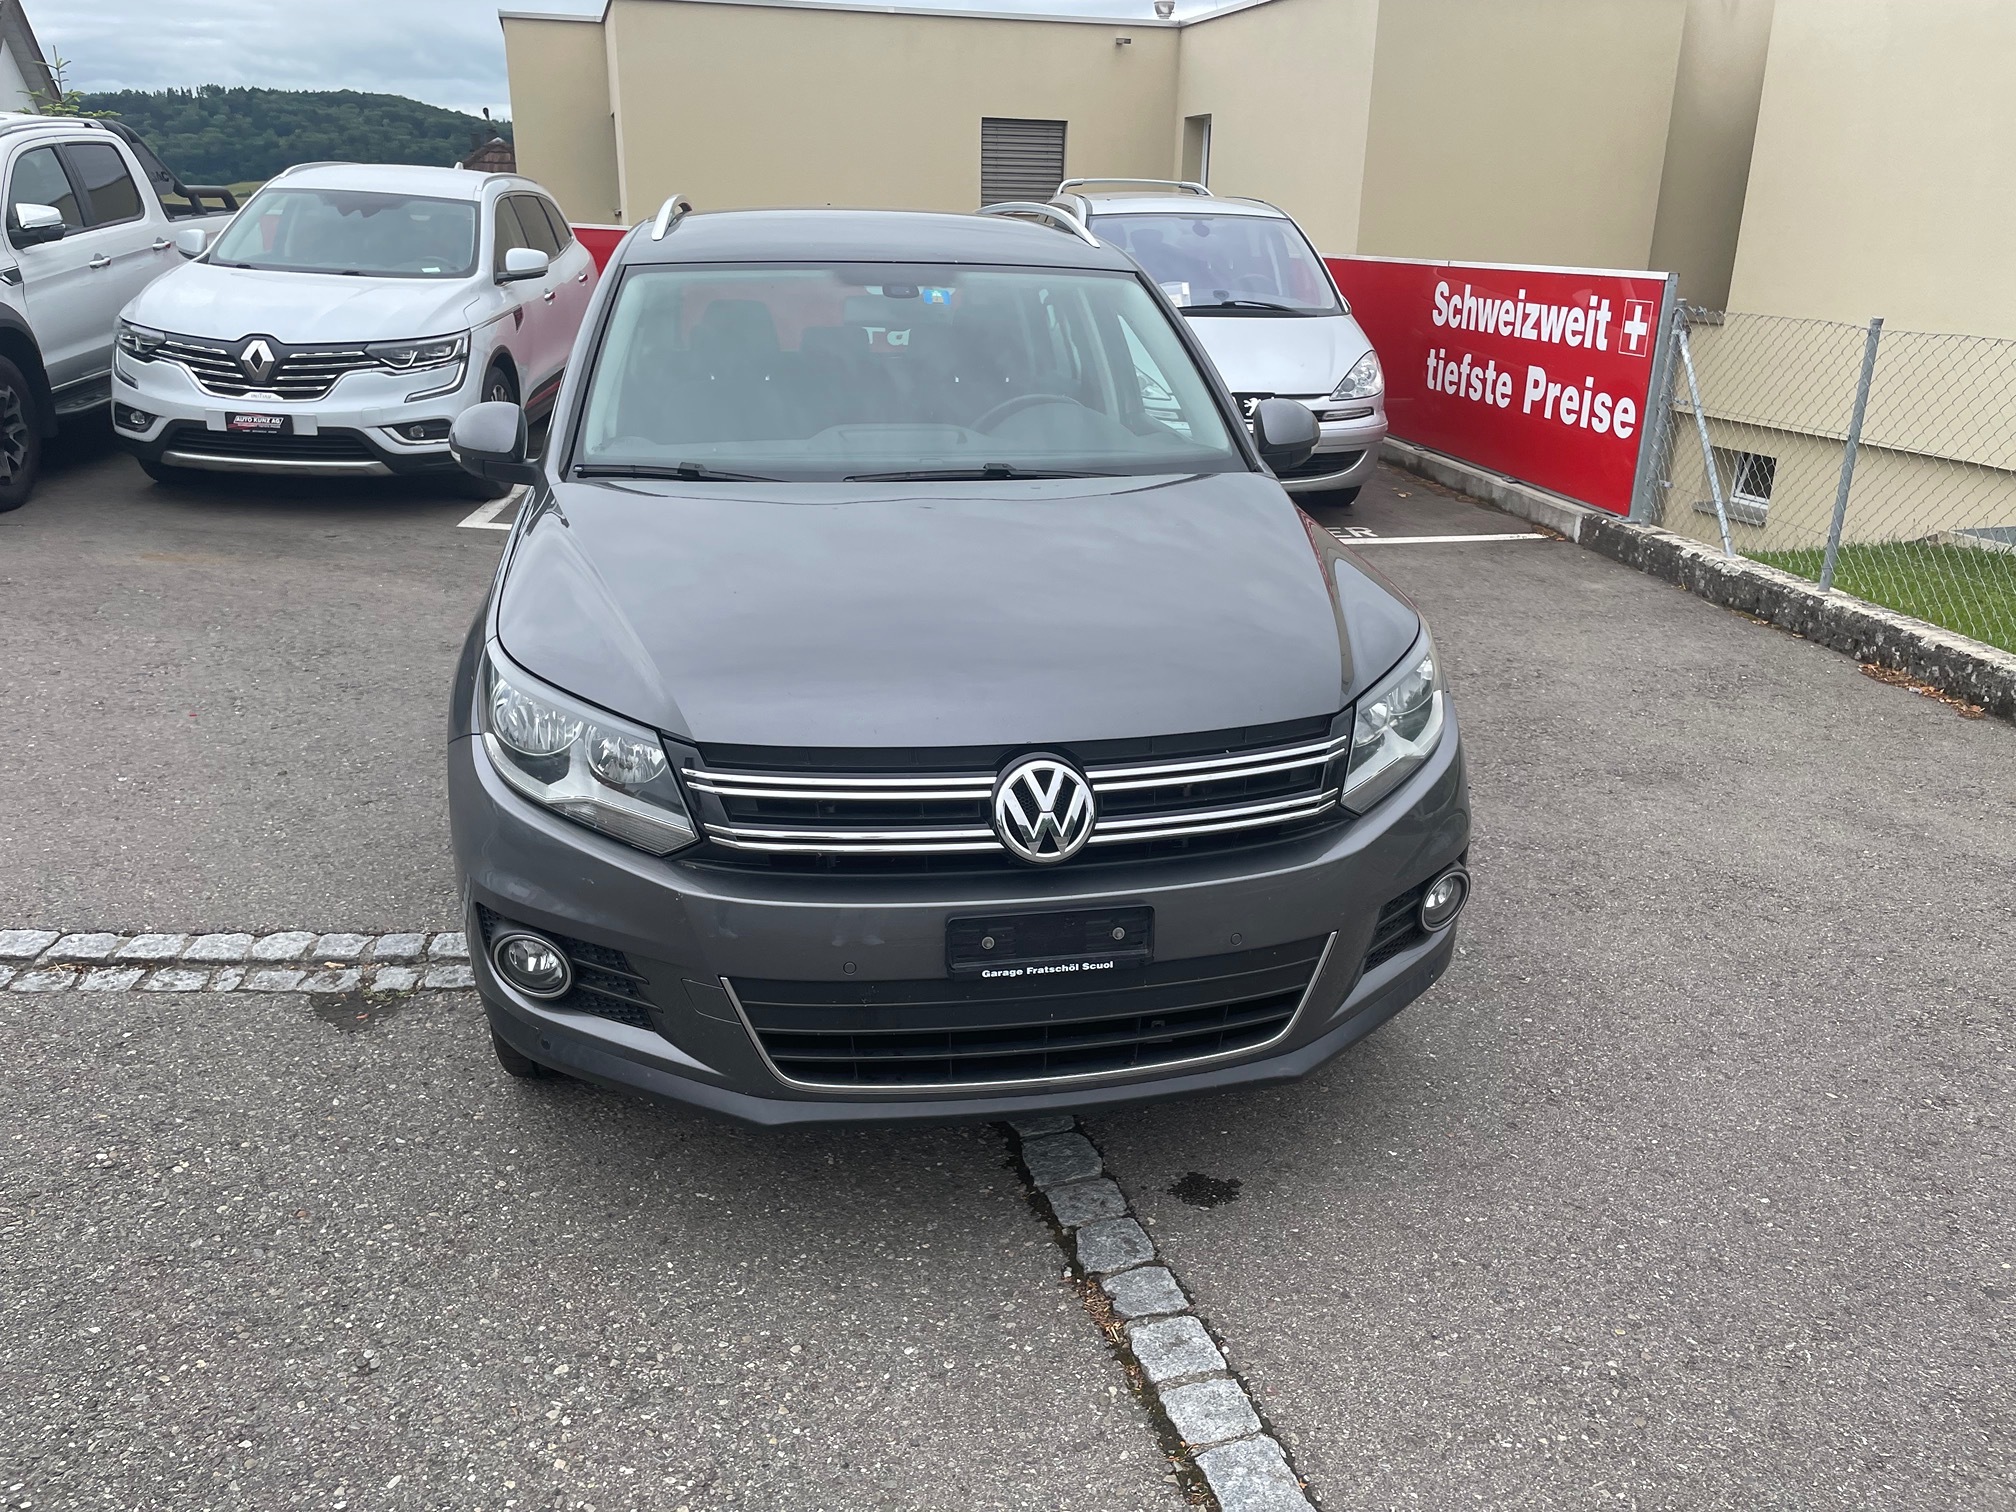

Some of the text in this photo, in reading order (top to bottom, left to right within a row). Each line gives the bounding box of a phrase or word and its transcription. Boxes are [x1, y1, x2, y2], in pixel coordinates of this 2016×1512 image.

[1432, 281, 1612, 351] Schweizweit
[1426, 348, 1636, 439] tiefste Preise
[981, 960, 1114, 978] Garage Fratschöl Scuol
